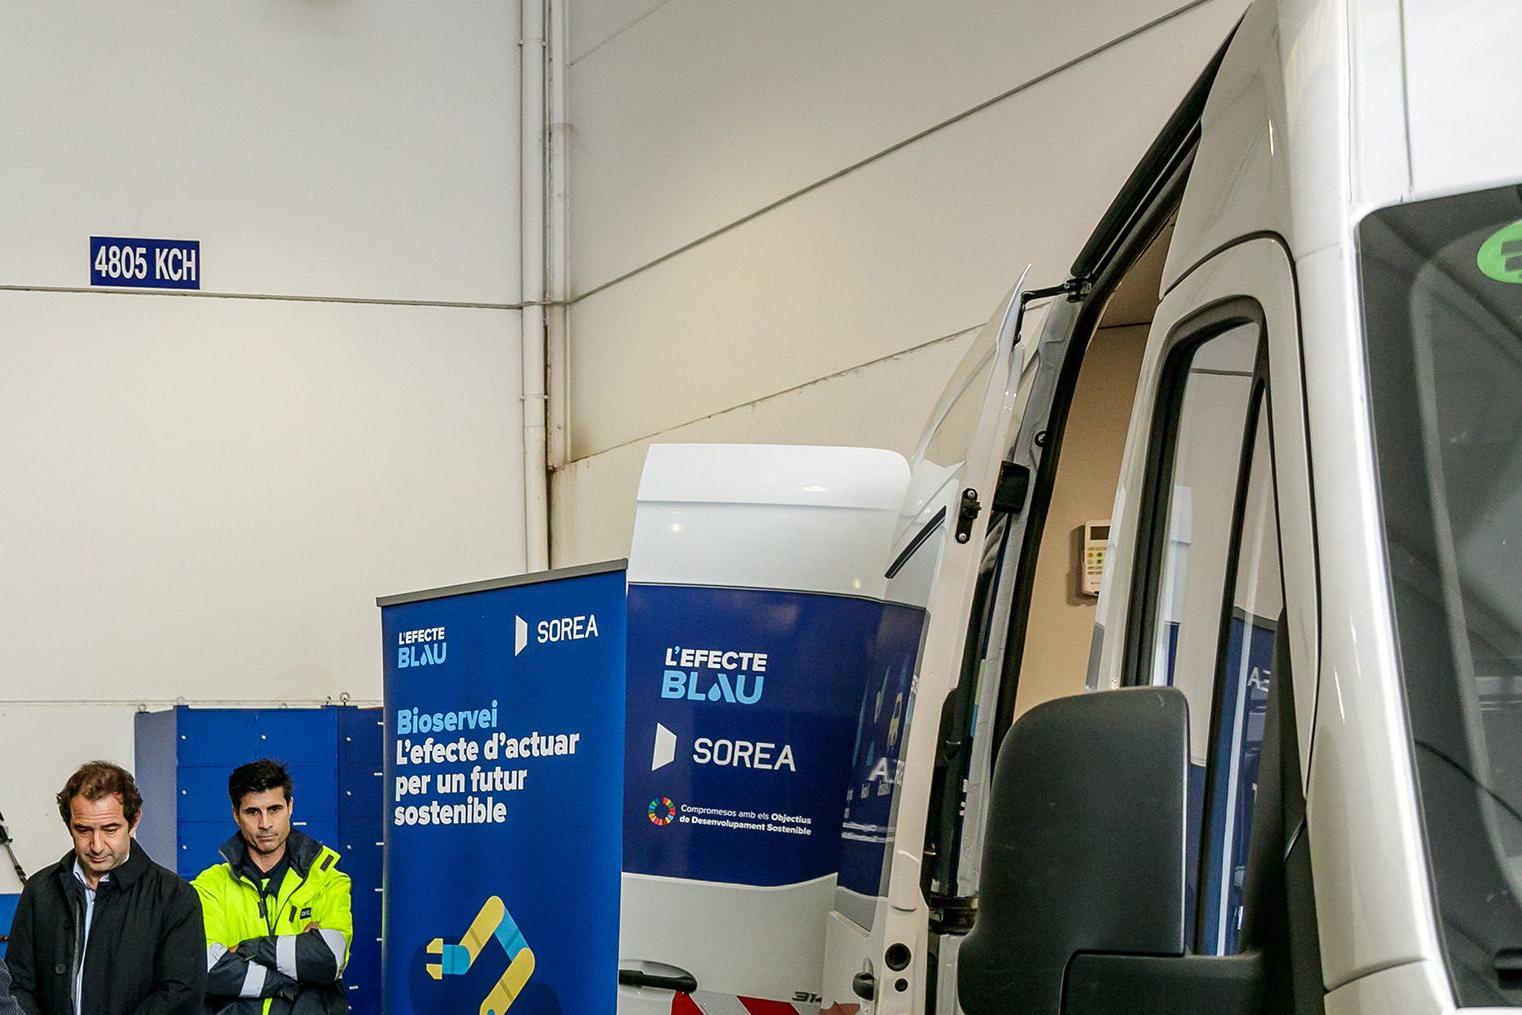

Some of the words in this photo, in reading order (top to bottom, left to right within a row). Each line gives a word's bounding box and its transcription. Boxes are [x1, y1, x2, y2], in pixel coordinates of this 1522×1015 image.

[94, 244, 148, 280] 4805
[155, 247, 197, 282] KCH
[398, 626, 445, 645] L'EFECTE
[537, 614, 599, 645] SOREA
[397, 642, 447, 669] BLAU
[665, 645, 768, 672] L'EFECTE
[661, 670, 765, 705] BLAU
[397, 700, 498, 735] Bioservei
[396, 737, 479, 765] L'efecte
[483, 731, 580, 760] d'actuar
[692, 737, 796, 772] SOREA
[395, 773, 431, 802] per
[437, 774, 466, 794] un
[470, 766, 528, 793] futur
[394, 796, 507, 826] sostenible
[679, 815, 690, 824] de
[691, 816, 766, 831] Desenvolupament
[766, 823, 812, 836] Sostenible
[680, 804, 737, 818] Compromesos
[738, 810, 756, 819] amb
[757, 812, 770, 821] els
[770, 812, 812, 825] Objectius
